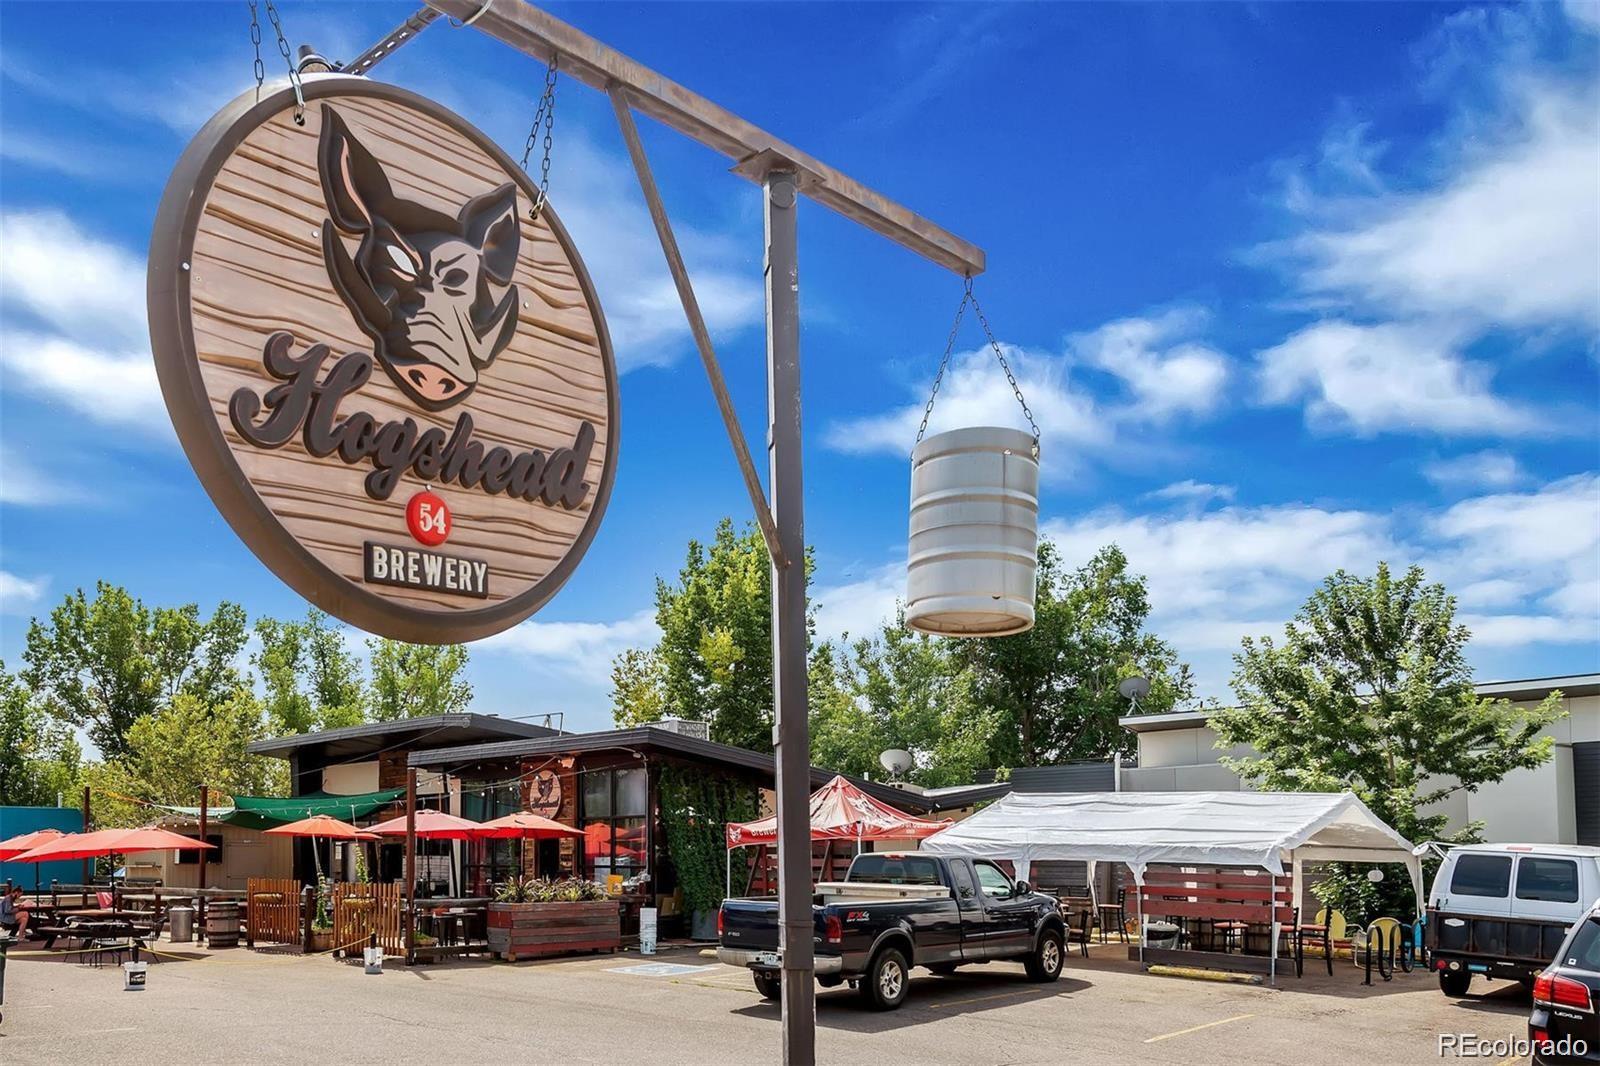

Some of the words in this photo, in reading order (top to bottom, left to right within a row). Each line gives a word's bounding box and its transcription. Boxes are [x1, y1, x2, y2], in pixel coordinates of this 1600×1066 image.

[229, 332, 597, 511] Hogshead
[418, 503, 447, 535] 54
[371, 546, 488, 594] BREWERY
[1554, 1010, 1583, 1020] LEXUS
